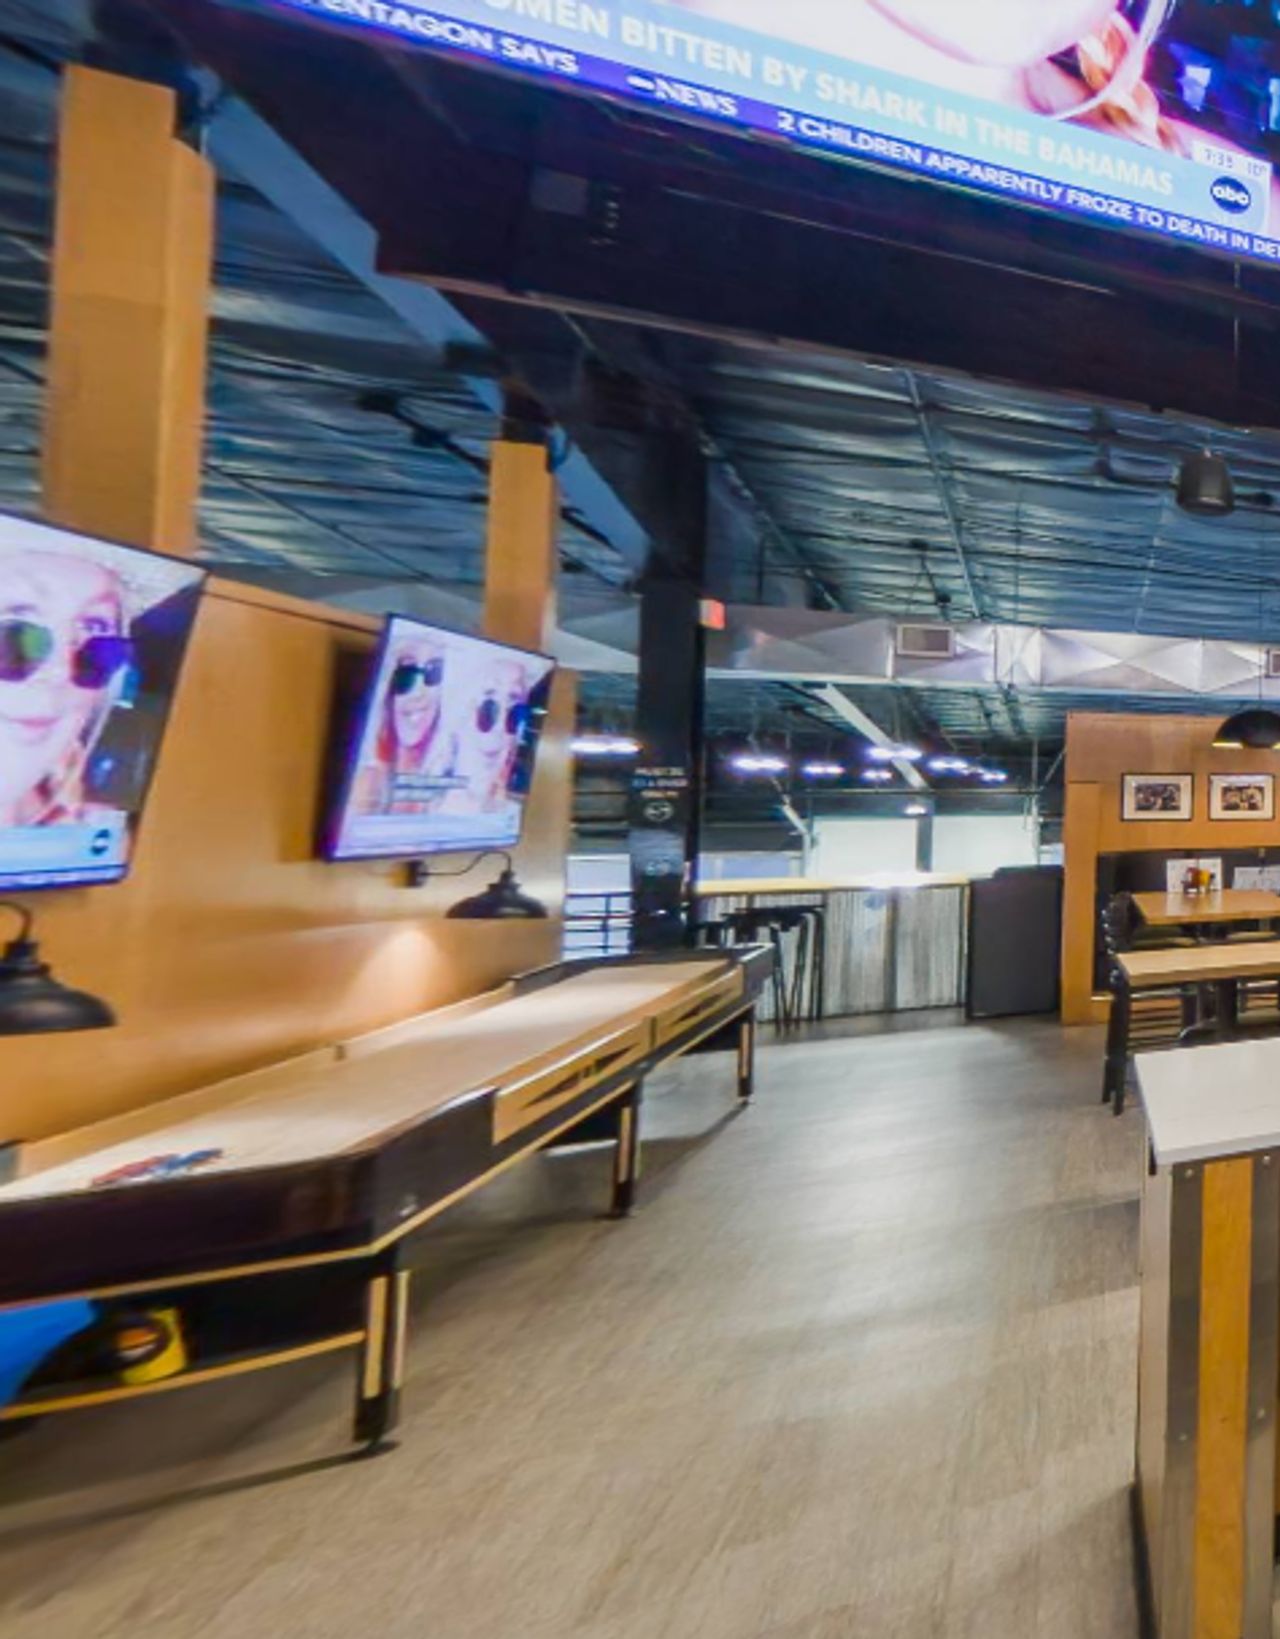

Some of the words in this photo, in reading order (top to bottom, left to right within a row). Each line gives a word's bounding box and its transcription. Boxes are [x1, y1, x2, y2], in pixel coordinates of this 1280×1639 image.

[304, 0, 494, 50] ENTAGON
[501, 37, 579, 74] SAYS
[485, 0, 609, 39] MEN
[621, 15, 752, 79] BITTEN
[763, 56, 808, 93] BY
[815, 68, 929, 129] SHARK
[934, 103, 969, 141] IN
[975, 116, 1030, 157] THE
[1039, 135, 1175, 196] BAHAMAS
[777, 111, 795, 132] 2
[800, 119, 923, 164] CHILDREN
[926, 150, 1062, 201] APPARENTLY
[1066, 189, 1134, 221] FROZE
[1136, 206, 1163, 228] TO
[1167, 215, 1227, 245] DEATH
[1230, 231, 1249, 251] IN
[1212, 185, 1249, 205] abc
